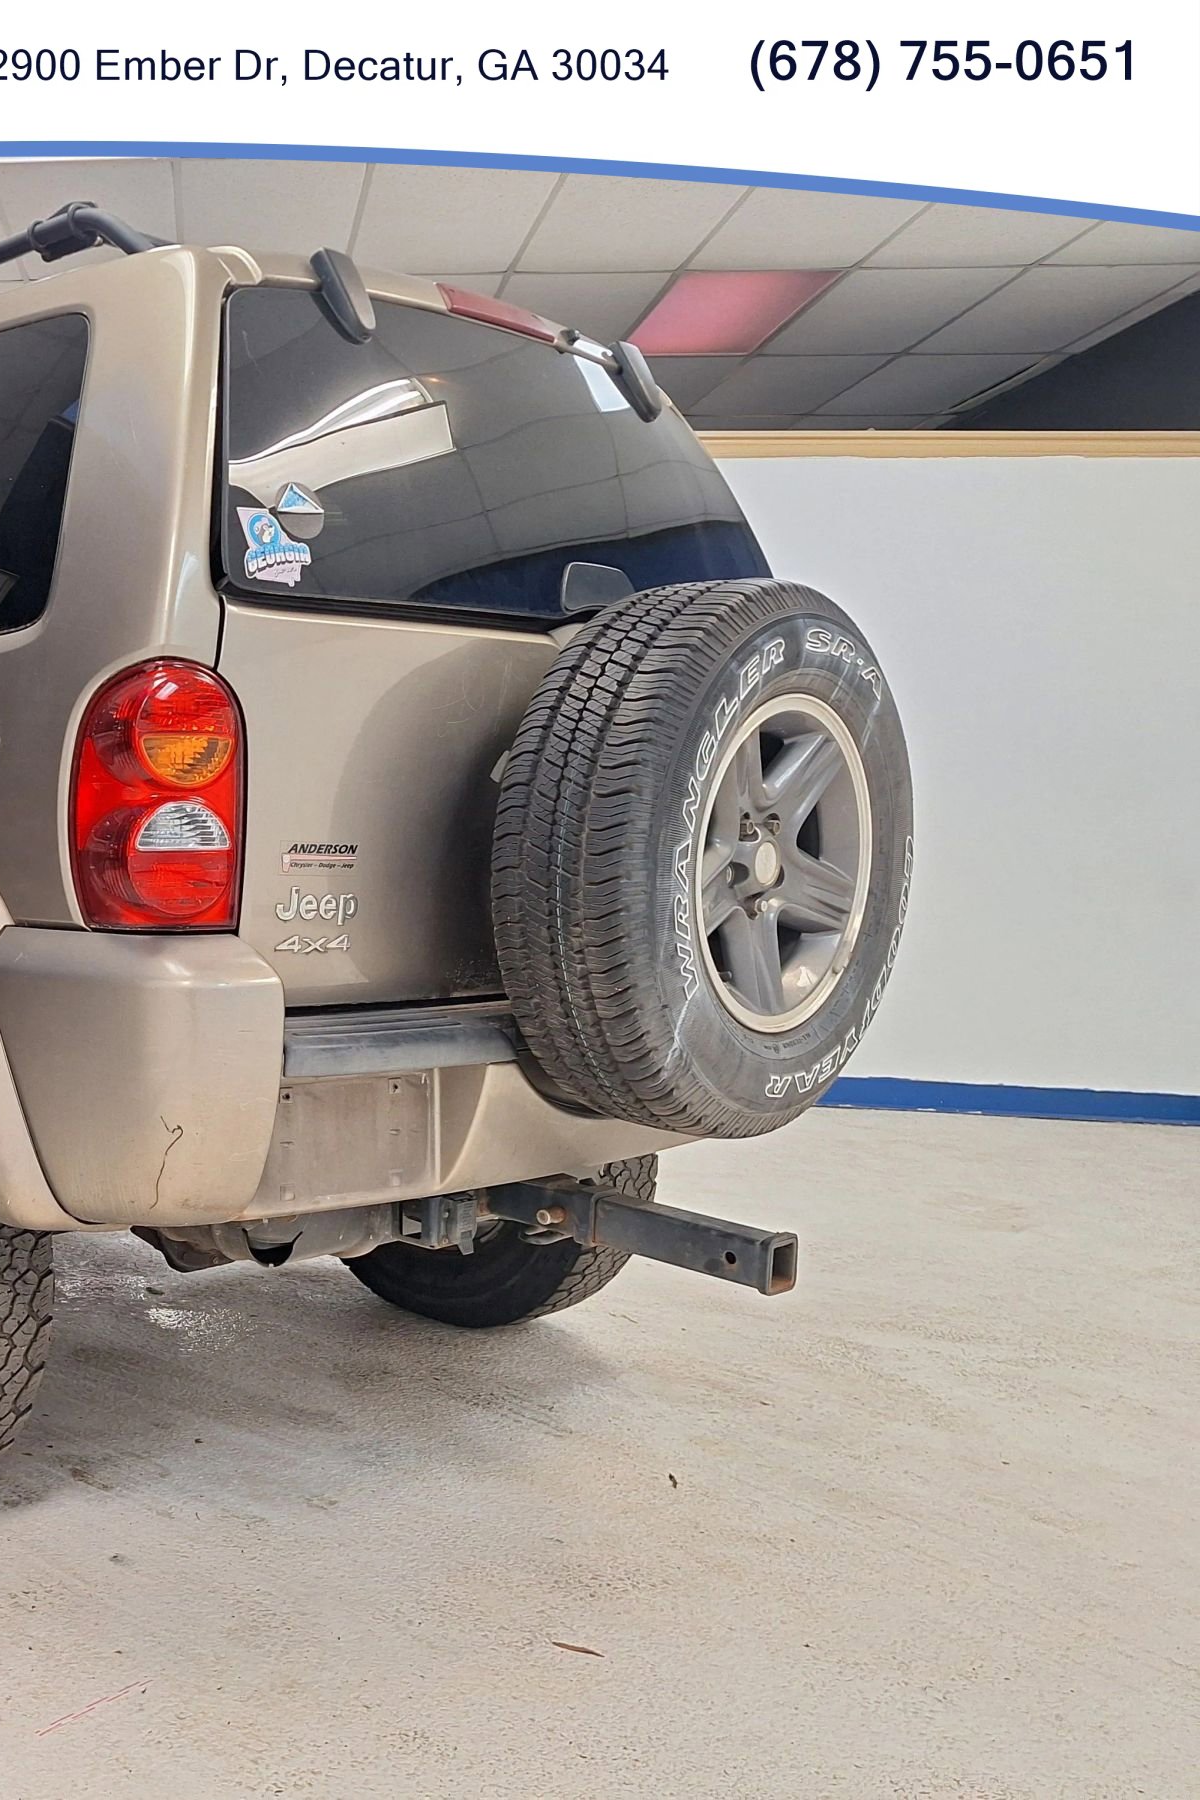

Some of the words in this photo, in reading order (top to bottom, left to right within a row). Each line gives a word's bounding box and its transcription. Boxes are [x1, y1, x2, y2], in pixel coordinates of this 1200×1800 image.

[671, 638, 785, 1000] WRANGLER
[288, 843, 358, 855] ANDERSON
[275, 886, 358, 926] Jeep
